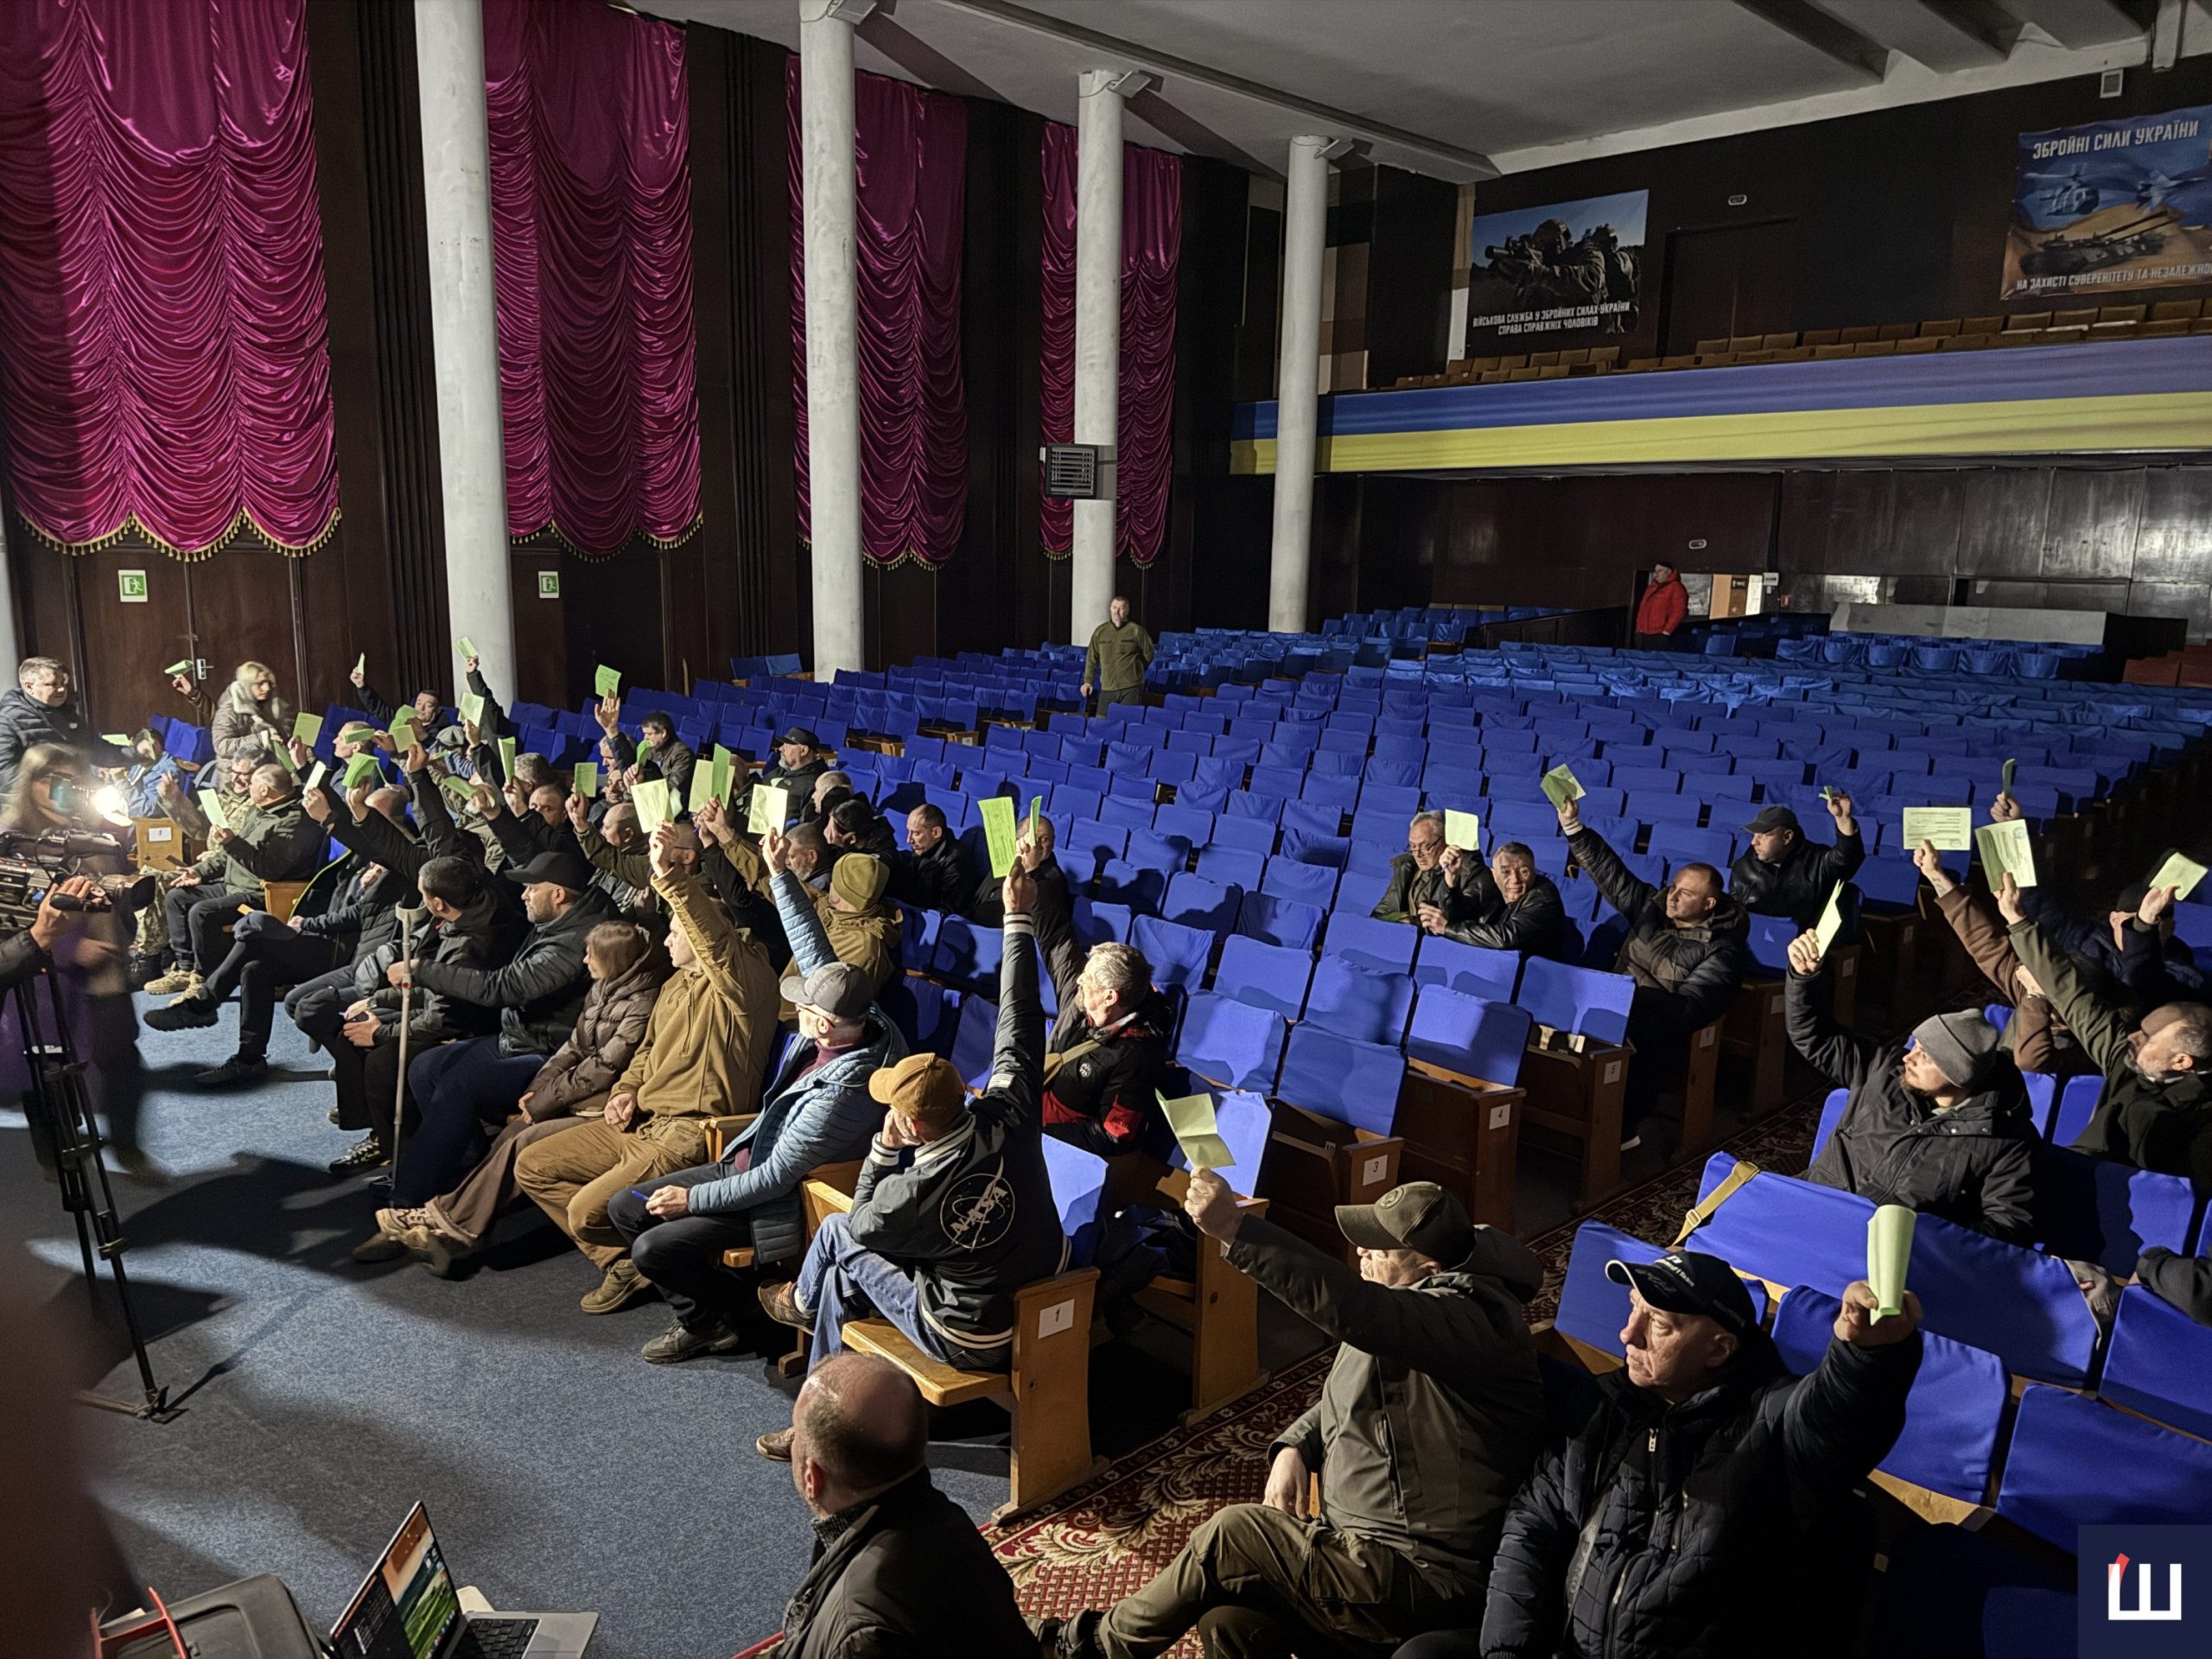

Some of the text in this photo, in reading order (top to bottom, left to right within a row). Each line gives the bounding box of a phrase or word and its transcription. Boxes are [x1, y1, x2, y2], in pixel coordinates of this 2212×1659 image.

[2032, 119, 2199, 160] ЗБРОЙНІ СИЛИ УКРАЇНИ
[2017, 279, 2028, 290] НА
[2030, 276, 2066, 289] ЗАХИСТІ
[2069, 269, 2134, 286] СУВЕРЕНІТЕТУ
[2137, 267, 2148, 279] ТА
[1472, 300, 1630, 327] ВІЙСЬКОВА СЛУЖБА У ЗБРОЙНИХ СИЛАХ УКРАЇНИ
[1498, 316, 1599, 335] СПРАВА СПРАВЖНІХ ЧОЛОВІКІВ
[1373, 1160, 1379, 1173] 3
[950, 1186, 1008, 1244] NASA
[1055, 1307, 1061, 1322] 1
